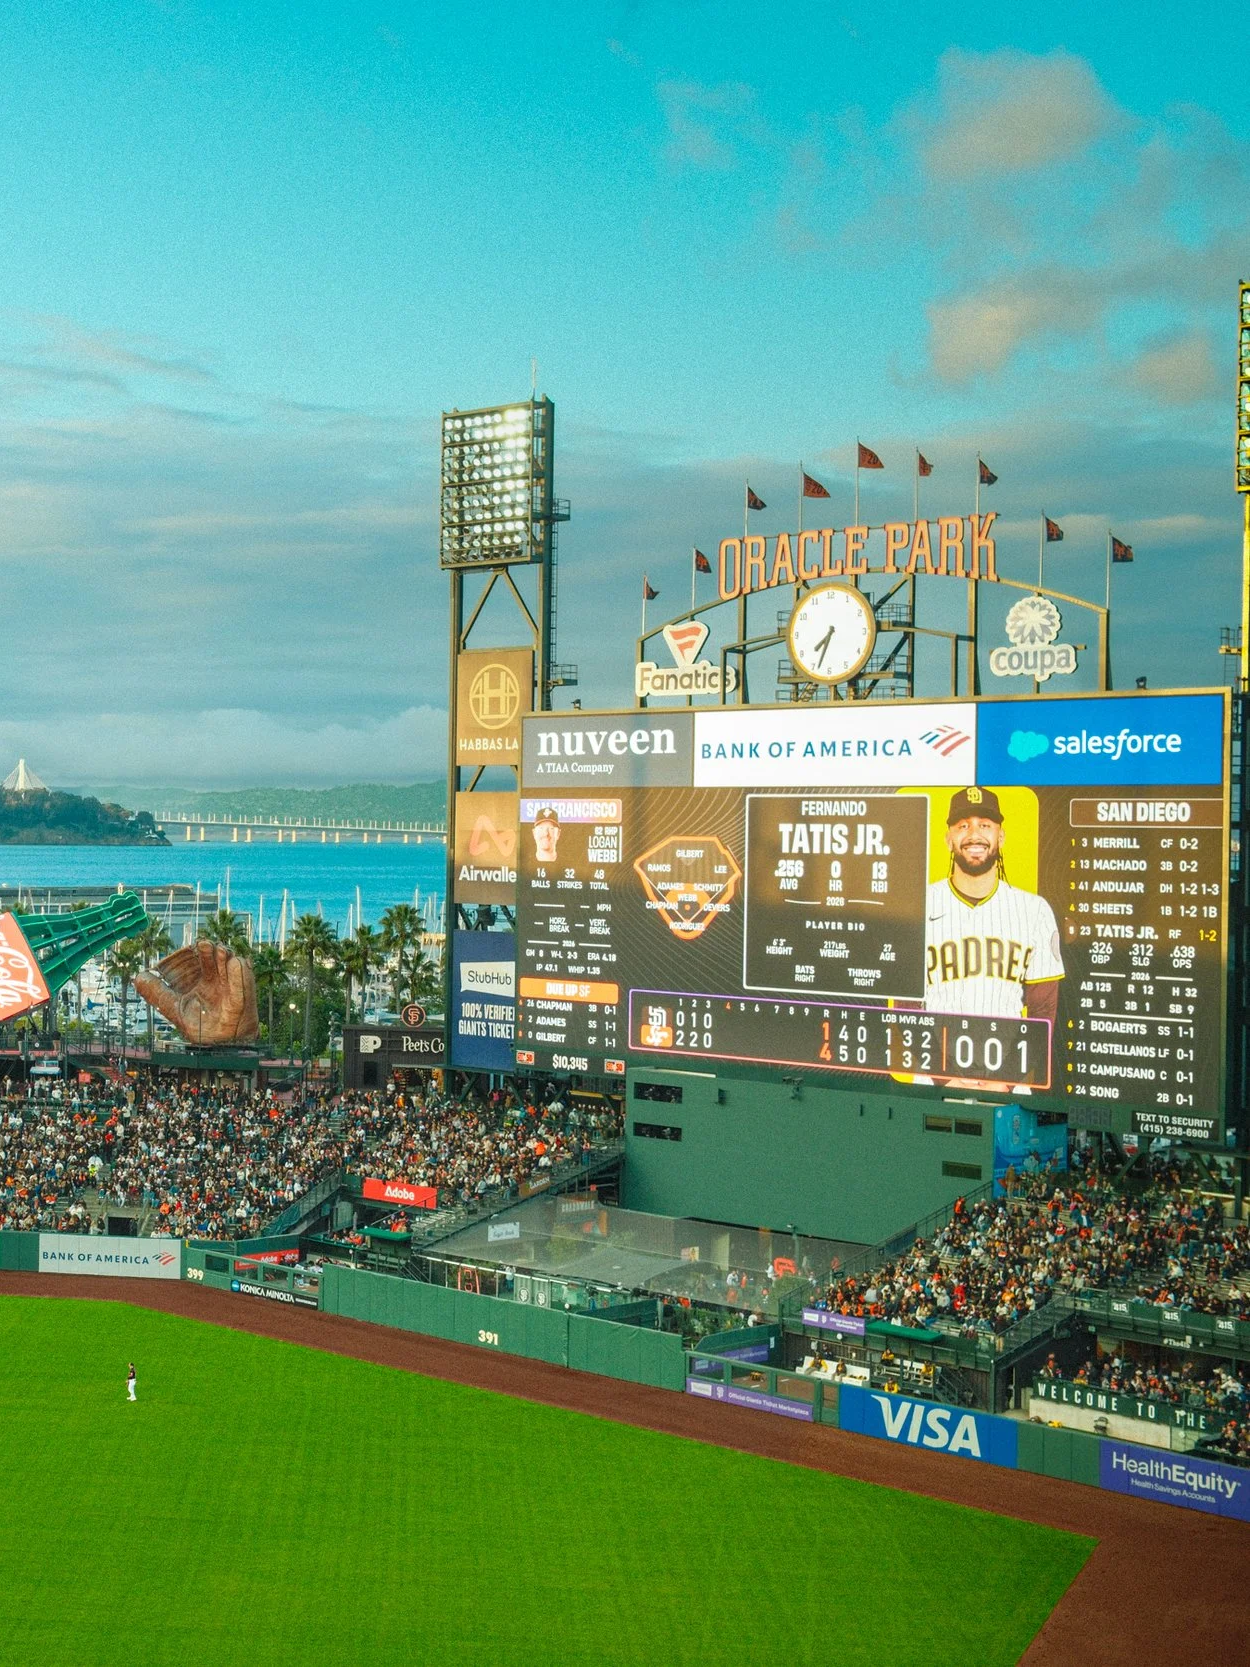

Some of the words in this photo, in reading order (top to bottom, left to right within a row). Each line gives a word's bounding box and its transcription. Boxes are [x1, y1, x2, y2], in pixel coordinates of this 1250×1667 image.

[718, 525, 869, 600] ORACLE
[884, 512, 999, 582] PARK
[994, 646, 1072, 676] coupa
[638, 662, 734, 692] Fanatics
[460, 738, 503, 751] HABBAS
[537, 725, 677, 757] nuveen
[1053, 730, 1182, 761] salesforce
[701, 742, 761, 761] BANK
[768, 740, 796, 759] OF
[801, 738, 912, 758] AMERICA
[536, 763, 544, 773] A
[546, 763, 569, 773] TIAA
[571, 763, 614, 775] Company
[553, 802, 617, 818] FRANCISCO
[801, 801, 867, 816] FERNANDO
[1097, 802, 1133, 822] SAN
[1136, 802, 1191, 822] DIEGO
[588, 836, 617, 849] LOGAN
[779, 823, 849, 854] TATIS
[854, 824, 890, 856] JR.
[1093, 838, 1140, 848] MERRILL
[1180, 838, 1198, 850] 0-2
[588, 849, 618, 862] WEBB
[676, 850, 704, 858] GILBERT
[647, 864, 672, 872] RAMOS
[714, 866, 728, 874] LEE
[775, 860, 804, 877] .256
[831, 861, 841, 878] 0
[1093, 860, 1147, 871] MACHADO
[1180, 860, 1198, 872] 0-2
[459, 865, 517, 883] Airwalle
[532, 880, 550, 888] BALLS
[557, 880, 582, 889] STRIKES
[590, 882, 609, 890] TOTAL
[656, 882, 685, 891] ADAMES
[693, 884, 724, 892] SCHMITT
[780, 879, 798, 890] AVG
[829, 879, 842, 891] HR
[871, 881, 888, 893] RBI
[1092, 882, 1144, 894] ANDUJAR
[1180, 883, 1198, 895] 1-2
[1202, 884, 1220, 896] 1-3
[678, 894, 698, 902] WEBB
[646, 901, 678, 910] CHAPMAN
[703, 904, 730, 912] DEVERS
[1092, 904, 1133, 915] SHEETS
[1180, 905, 1198, 917] 1-2
[1202, 906, 1218, 918] 1B
[806, 921, 843, 930] PLAYER
[1095, 924, 1134, 938] TATIS
[1136, 926, 1158, 940] JR.
[1200, 930, 1217, 942] 1-2
[820, 949, 850, 958] WEIGHT
[1089, 942, 1112, 954] .326
[1128, 944, 1154, 956] .312
[1170, 946, 1196, 958] .638
[1092, 954, 1110, 964] OBP
[1132, 956, 1150, 966] SLG
[1173, 958, 1192, 968] OPS
[468, 970, 512, 984] StubHub
[848, 968, 882, 978] THROWS
[854, 978, 874, 986] RIGHT
[565, 983, 578, 996] UP
[462, 1002, 483, 1018] 100%
[484, 1004, 514, 1020] VERIFIE
[536, 1000, 572, 1012] CHAPMAN
[536, 1016, 566, 1027] ADAMES
[882, 1014, 896, 1023] LOB
[899, 1014, 916, 1025] MVR
[918, 1016, 934, 1026] ABS
[458, 1020, 486, 1036] GIANTS
[488, 1022, 514, 1039] TICKET
[1090, 1020, 1148, 1034] BOGAERTS
[1178, 1026, 1194, 1038] 1-1
[536, 1032, 566, 1043] GILBERT
[402, 1036, 430, 1053] Peet's
[430, 1038, 444, 1054] Co
[1090, 1042, 1156, 1058] CASTELLANOS
[1176, 1048, 1194, 1060] 0-1
[956, 1036, 974, 1068] 0
[984, 1038, 1002, 1071] 0
[1017, 1041, 1028, 1074] 1
[552, 1055, 588, 1071] $10,345
[1090, 1064, 1155, 1080] CAMPUSANO
[1176, 1071, 1194, 1083] 0-1
[1090, 1086, 1119, 1098] SONG
[1176, 1093, 1194, 1106] 0-1
[1136, 1112, 1157, 1122] TEXT
[1158, 1114, 1170, 1124] TO
[1172, 1116, 1214, 1128] SECURITY
[1140, 1124, 1164, 1134] (415)
[1166, 1126, 1209, 1138] 238-6900
[384, 1184, 415, 1201] Adobe
[42, 1252, 74, 1262] BANK
[78, 1254, 92, 1263] OF
[95, 1254, 150, 1265] AMERICA
[186, 1268, 204, 1280] 399
[240, 1283, 266, 1297] KONICA
[266, 1290, 294, 1304] MINOLTA
[478, 1330, 498, 1346] 391
[1038, 1382, 1118, 1412] WELCOME
[1137, 1402, 1156, 1419] TO
[1175, 1410, 1206, 1430] THE
[870, 1394, 982, 1458] VISA
[1112, 1451, 1238, 1498] HealthEquity
[1131, 1478, 1154, 1490] Health
[1154, 1482, 1182, 1497] Savings
[1182, 1490, 1216, 1504] Accounts
